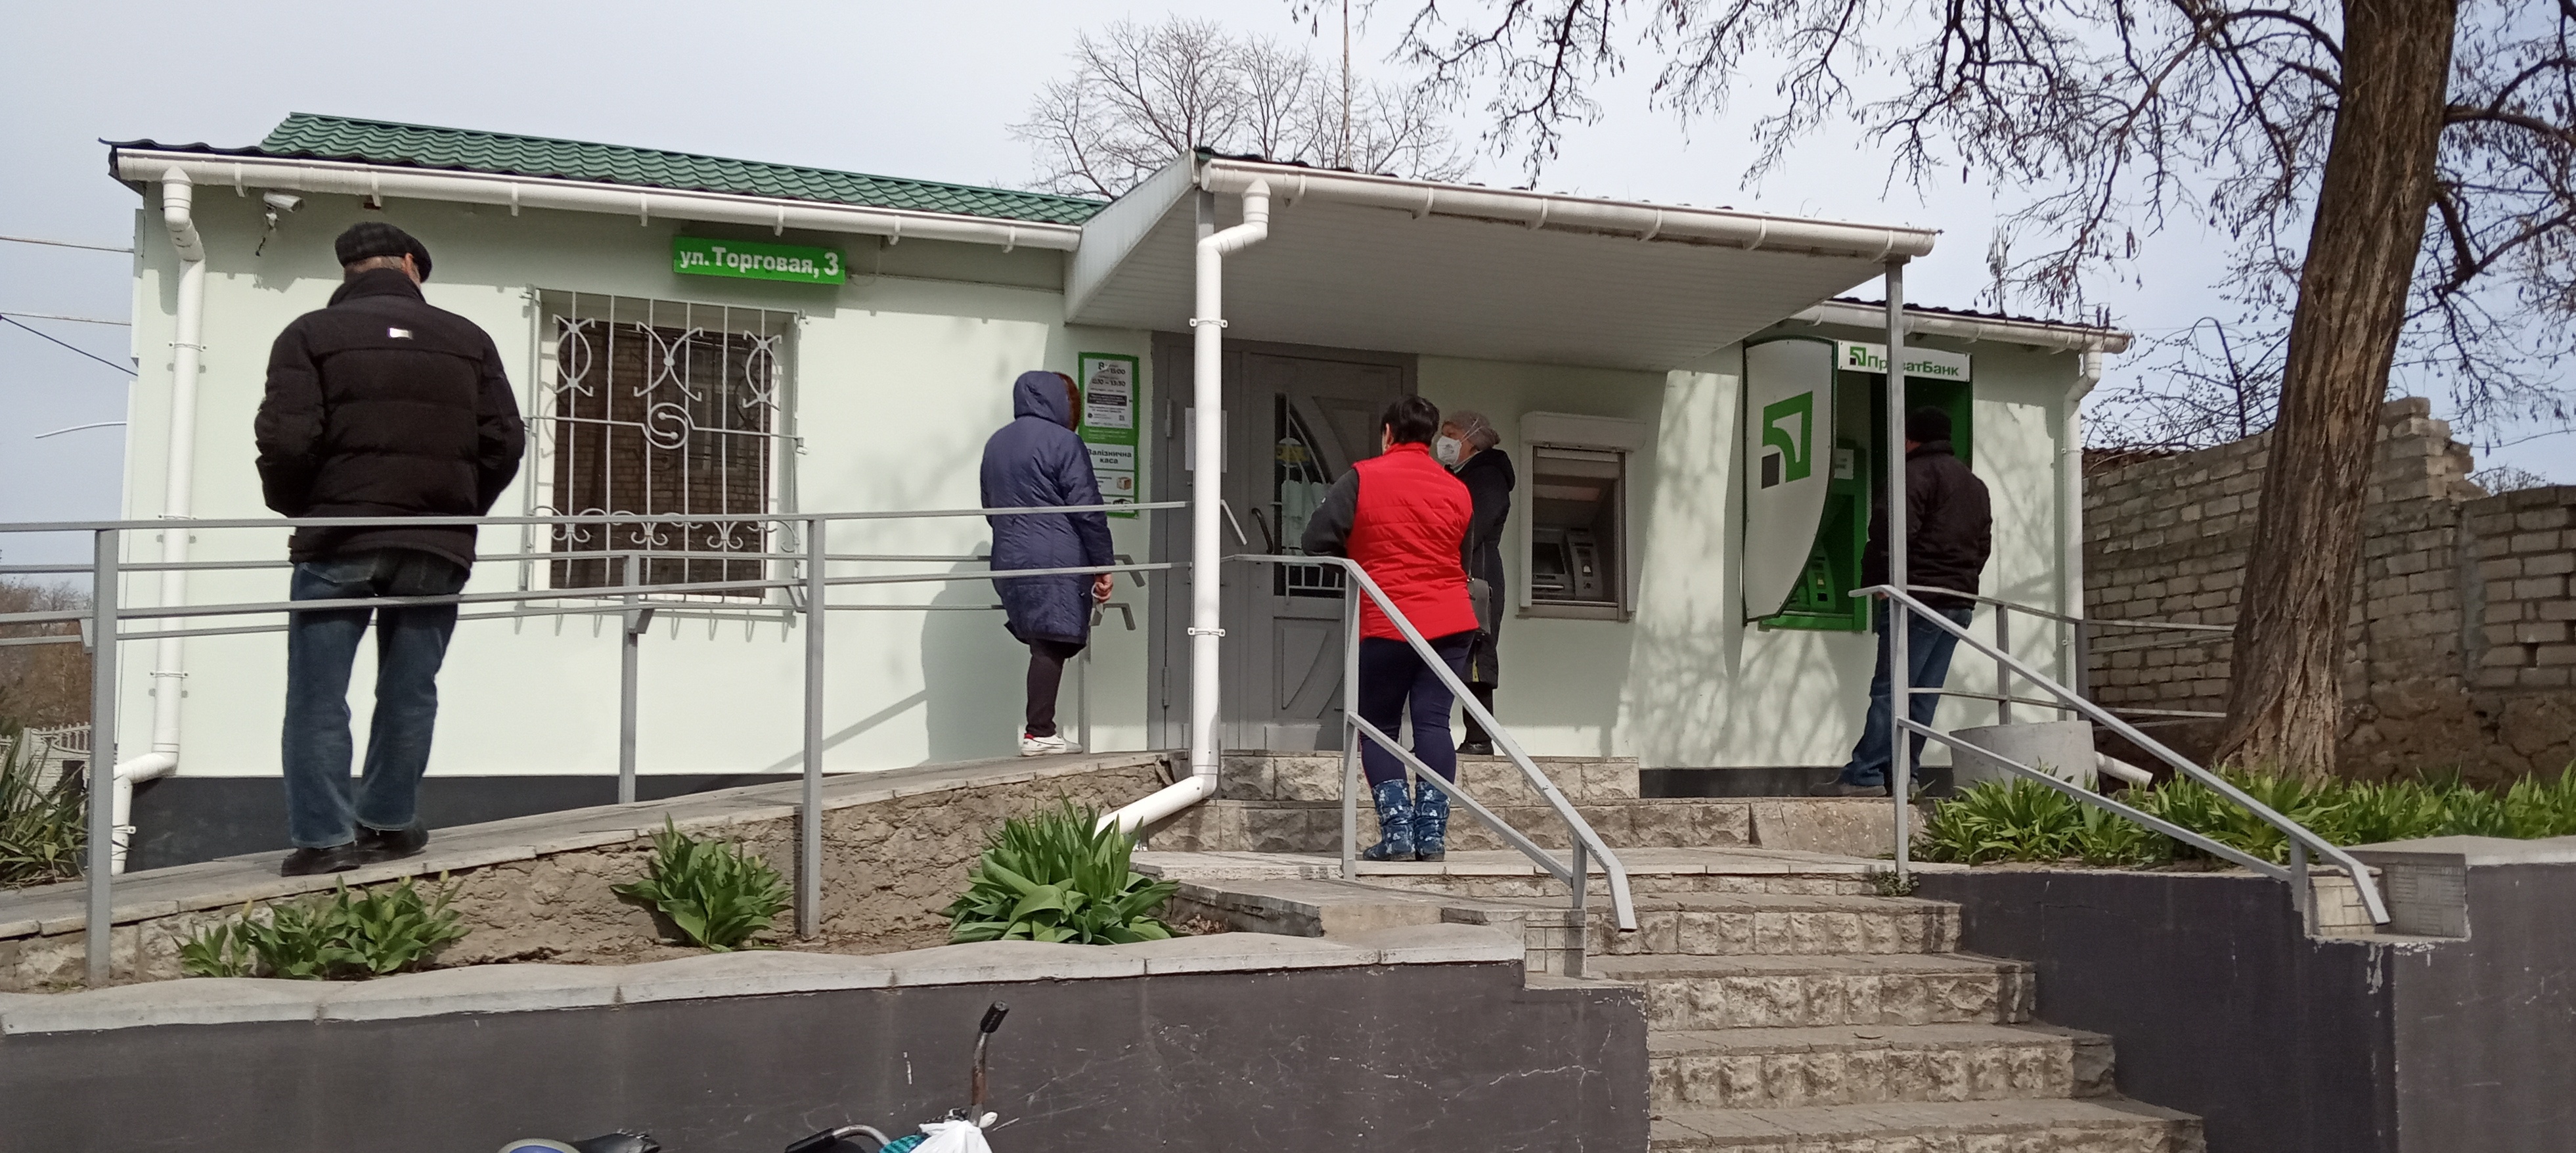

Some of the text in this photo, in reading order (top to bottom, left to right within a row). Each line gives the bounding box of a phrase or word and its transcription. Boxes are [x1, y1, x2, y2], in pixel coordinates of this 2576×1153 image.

[679, 246, 839, 279] ул. Торговая, 3
[1868, 355, 1959, 376] ПратБанк
